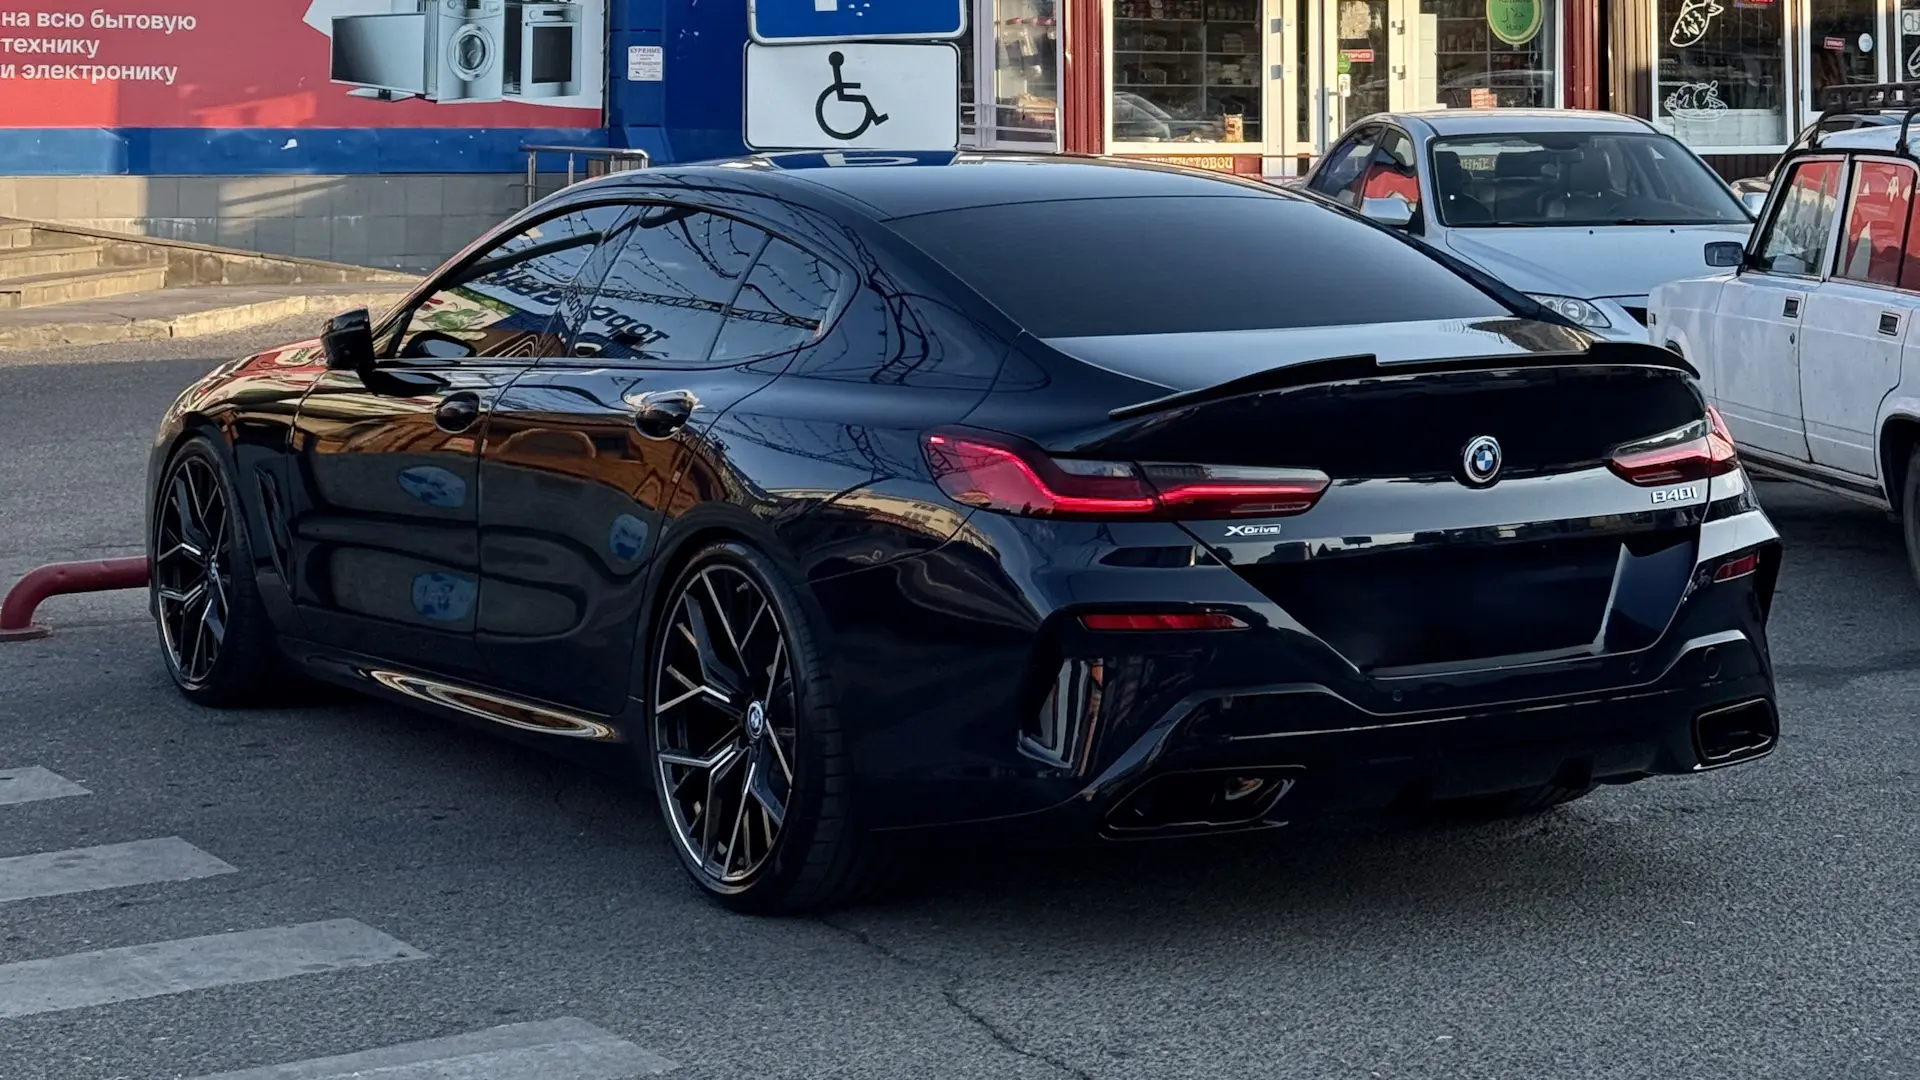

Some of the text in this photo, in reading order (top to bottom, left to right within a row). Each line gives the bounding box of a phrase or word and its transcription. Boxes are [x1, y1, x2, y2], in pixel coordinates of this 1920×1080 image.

[1, 9, 197, 34] на всю бытовую
[0, 37, 100, 58] технику
[0, 63, 178, 85] и электронику
